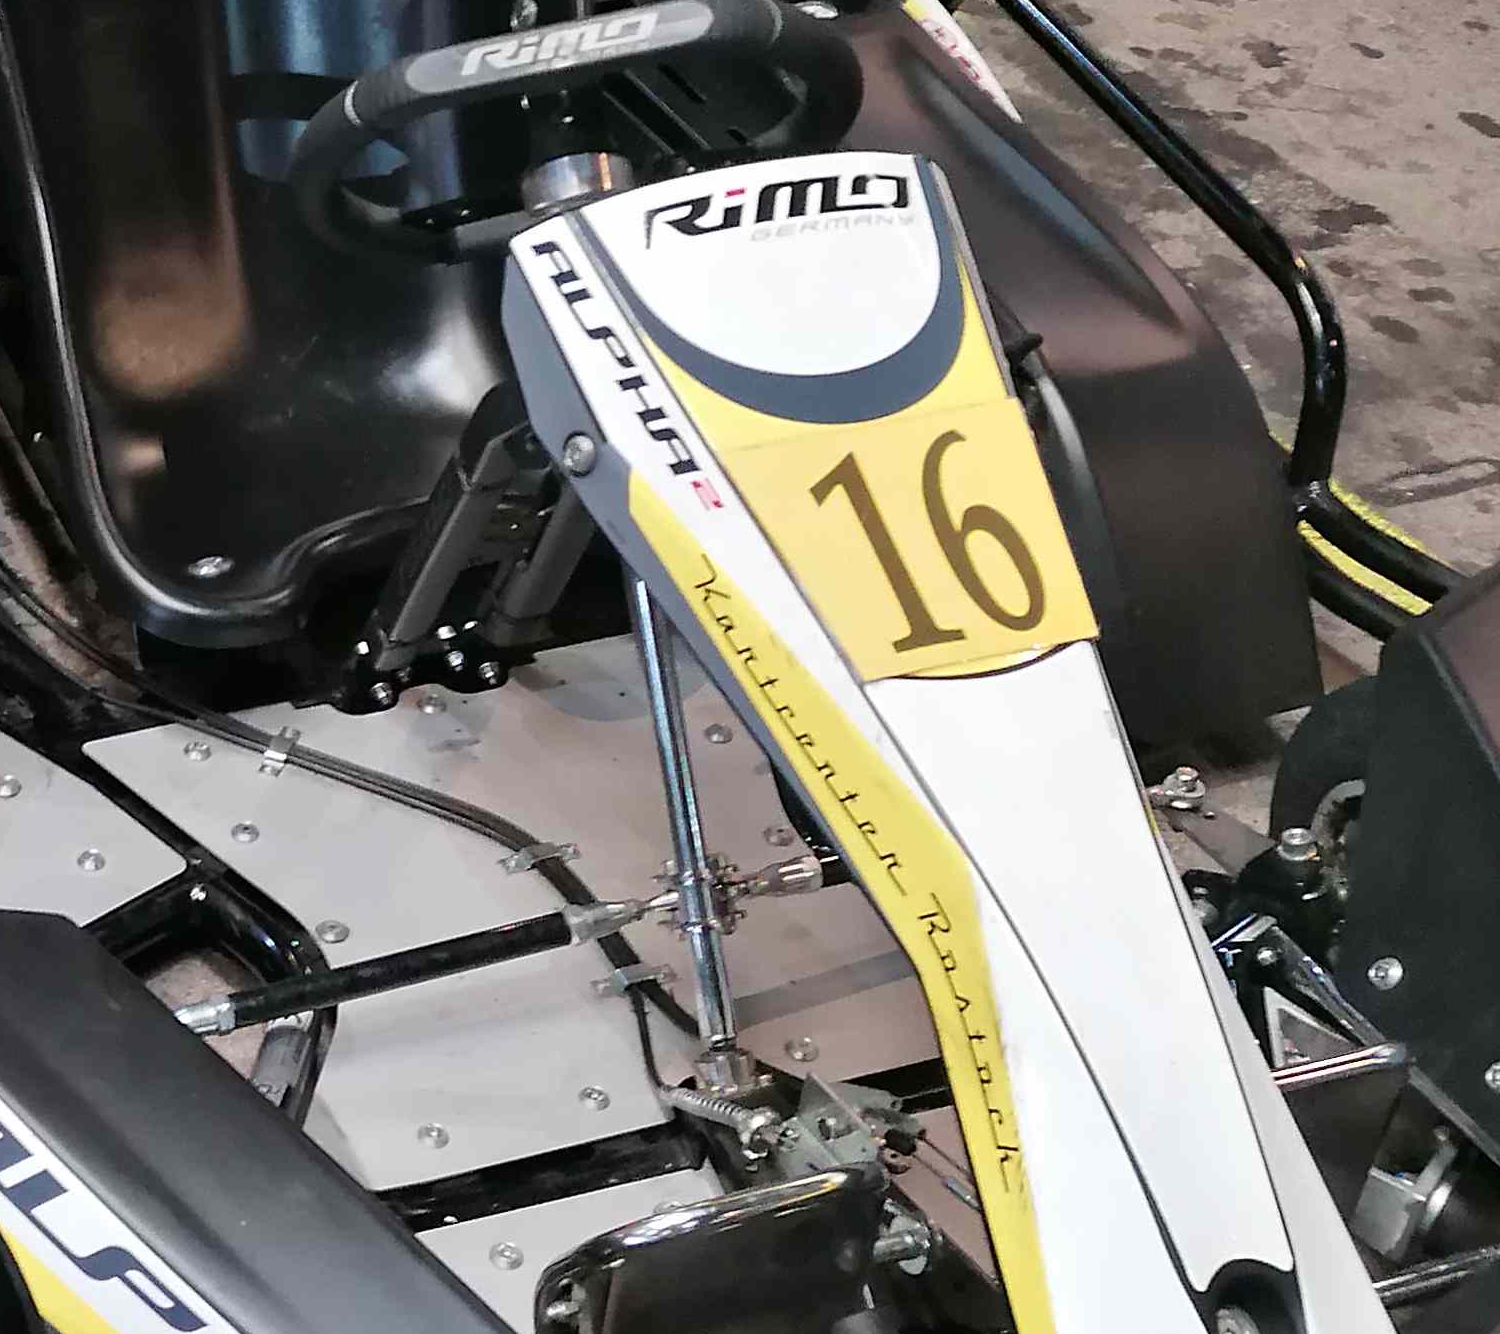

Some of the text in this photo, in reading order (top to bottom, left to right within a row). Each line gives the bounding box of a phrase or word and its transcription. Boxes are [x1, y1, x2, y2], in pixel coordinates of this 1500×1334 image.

[750, 212, 915, 243] GERMANY
[809, 429, 1046, 655] 16
[693, 554, 1017, 1192] Kartcenter Rostock
